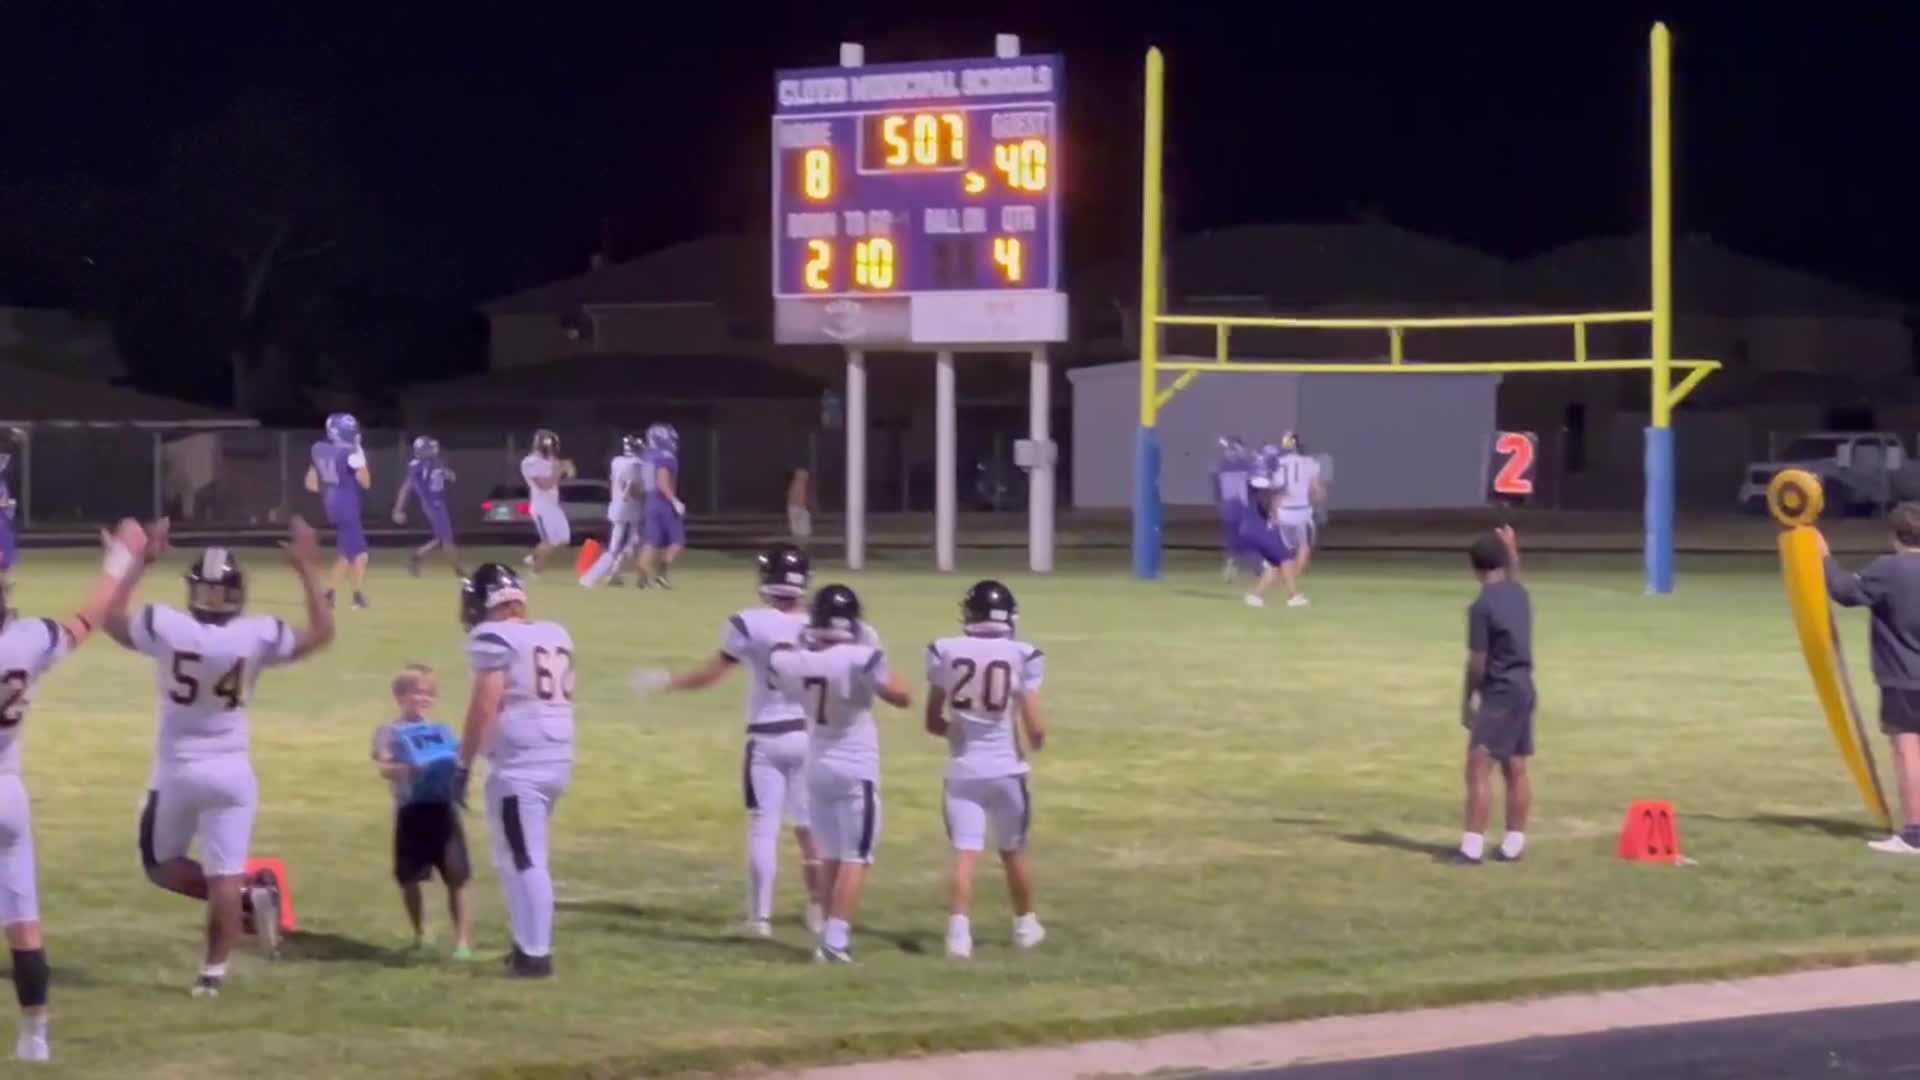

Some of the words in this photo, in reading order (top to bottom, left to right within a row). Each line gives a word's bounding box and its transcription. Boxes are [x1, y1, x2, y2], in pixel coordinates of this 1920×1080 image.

[805, 149, 831, 199] 8
[994, 139, 1047, 191] 40
[805, 239, 832, 290] 2
[855, 237, 894, 289] 10
[994, 237, 1021, 282] 4
[1494, 432, 1533, 493] 2
[170, 652, 246, 709] 54
[803, 677, 828, 725] 7
[951, 657, 1012, 712] 20
[1642, 808, 1674, 856] 20
